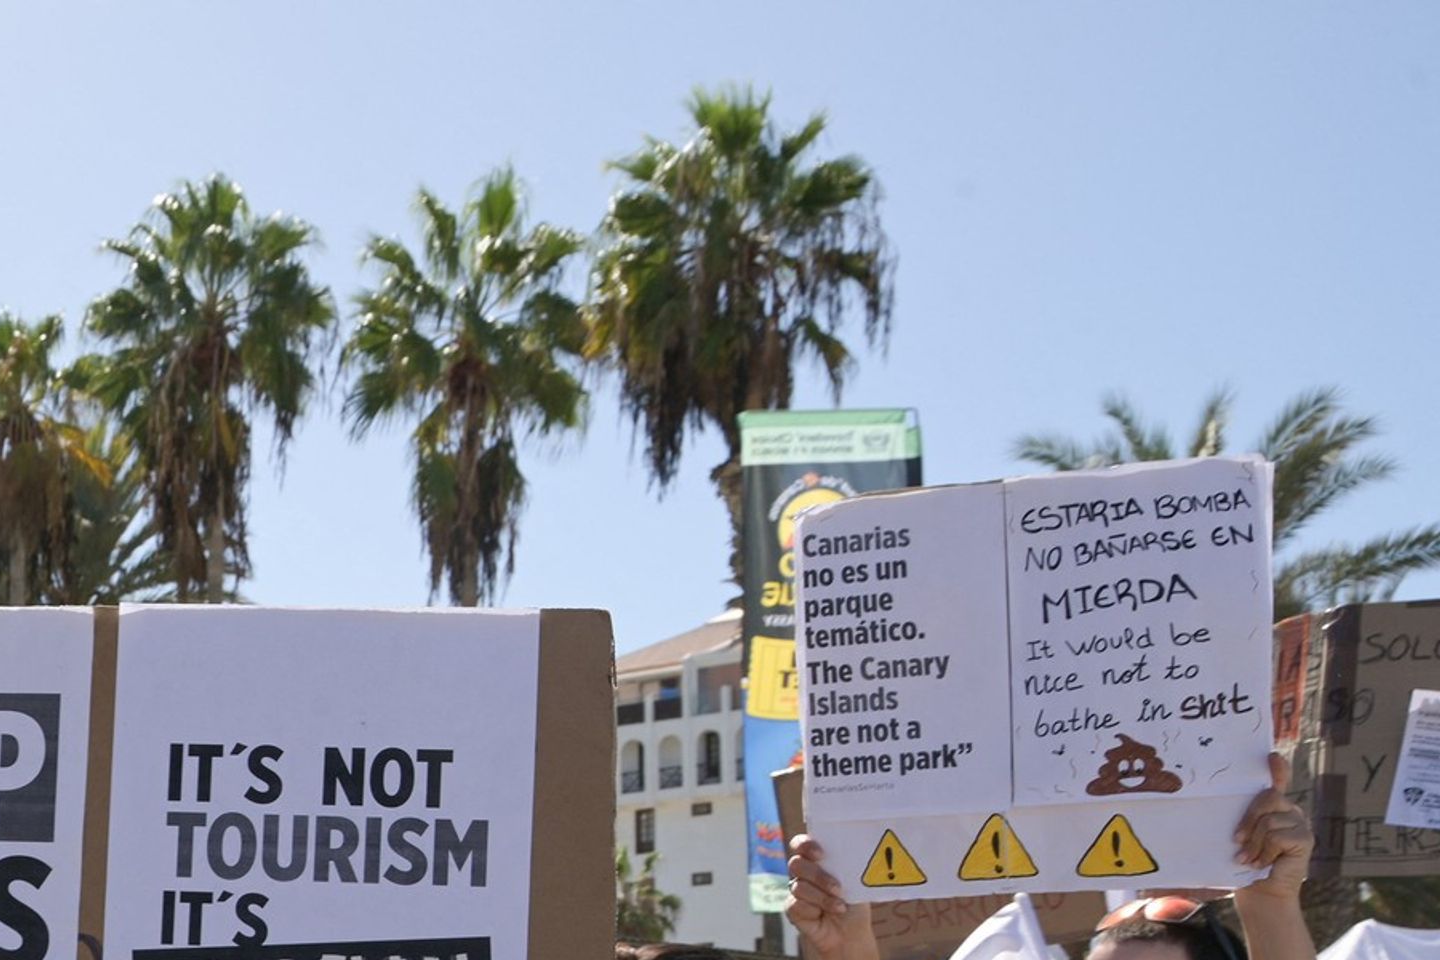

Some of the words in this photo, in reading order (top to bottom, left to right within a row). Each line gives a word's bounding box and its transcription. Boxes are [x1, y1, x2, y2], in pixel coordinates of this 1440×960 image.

[1021, 497, 1144, 534] ESTARIA
[1155, 488, 1252, 520] BOMBA
[802, 526, 912, 558] Canarias
[1024, 545, 1062, 572] NO
[1211, 523, 1254, 547] EN
[803, 567, 834, 589] no
[841, 563, 869, 585] es
[876, 559, 908, 580] un
[804, 591, 894, 623] parque
[1041, 573, 1198, 624] MIERDA
[805, 620, 926, 649] temático.
[1026, 639, 1054, 662] It
[1170, 622, 1212, 647] be
[806, 660, 853, 686] The
[860, 654, 951, 682] Canary
[1024, 671, 1084, 697] nice
[1102, 654, 1151, 686] not
[1164, 656, 1200, 681] to
[809, 686, 899, 716] Islands
[1034, 708, 1121, 738] bathe
[1137, 697, 1172, 723] in
[810, 724, 851, 747] are
[857, 718, 900, 744] not
[907, 719, 922, 740] a
[321, 746, 455, 809] NOT
[811, 753, 892, 778] theme
[166, 811, 490, 888] TOURISM
